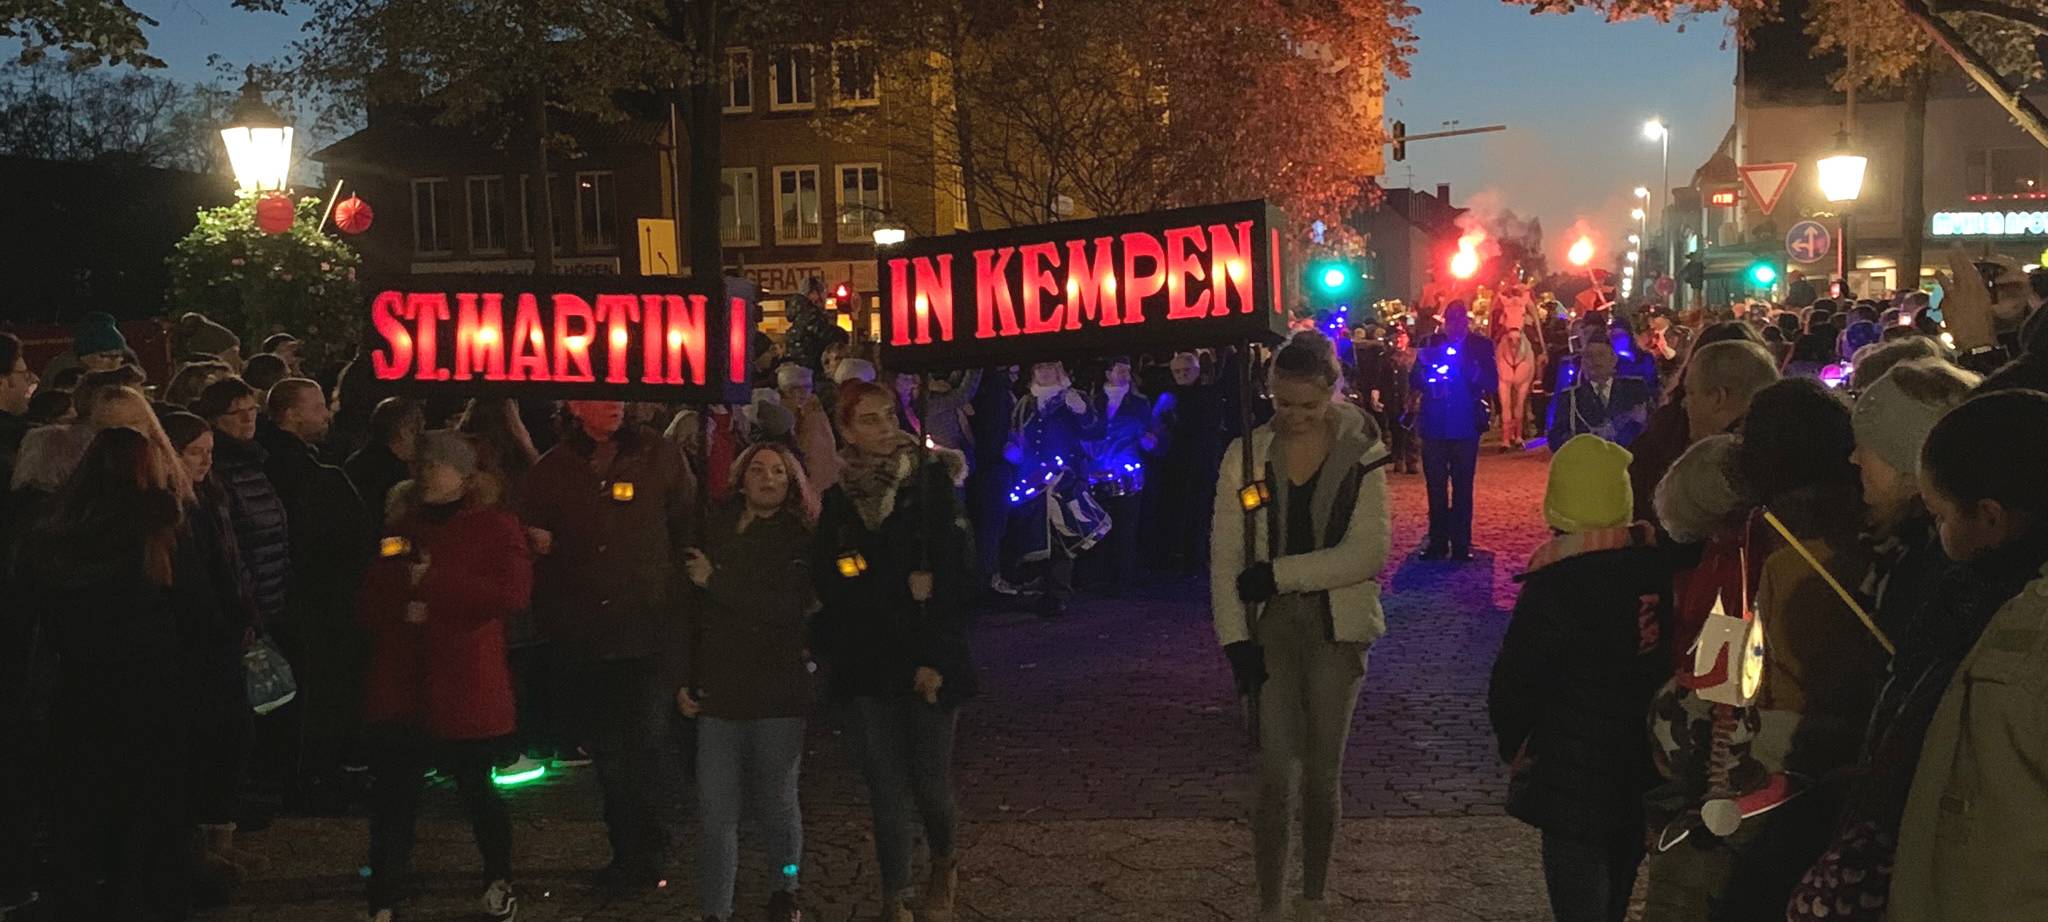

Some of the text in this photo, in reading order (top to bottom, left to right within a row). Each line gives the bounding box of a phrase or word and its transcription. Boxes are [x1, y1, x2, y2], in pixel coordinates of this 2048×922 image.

[371, 290, 708, 386] ST.MARTIN
[887, 219, 1254, 347] IN KEMPEN
